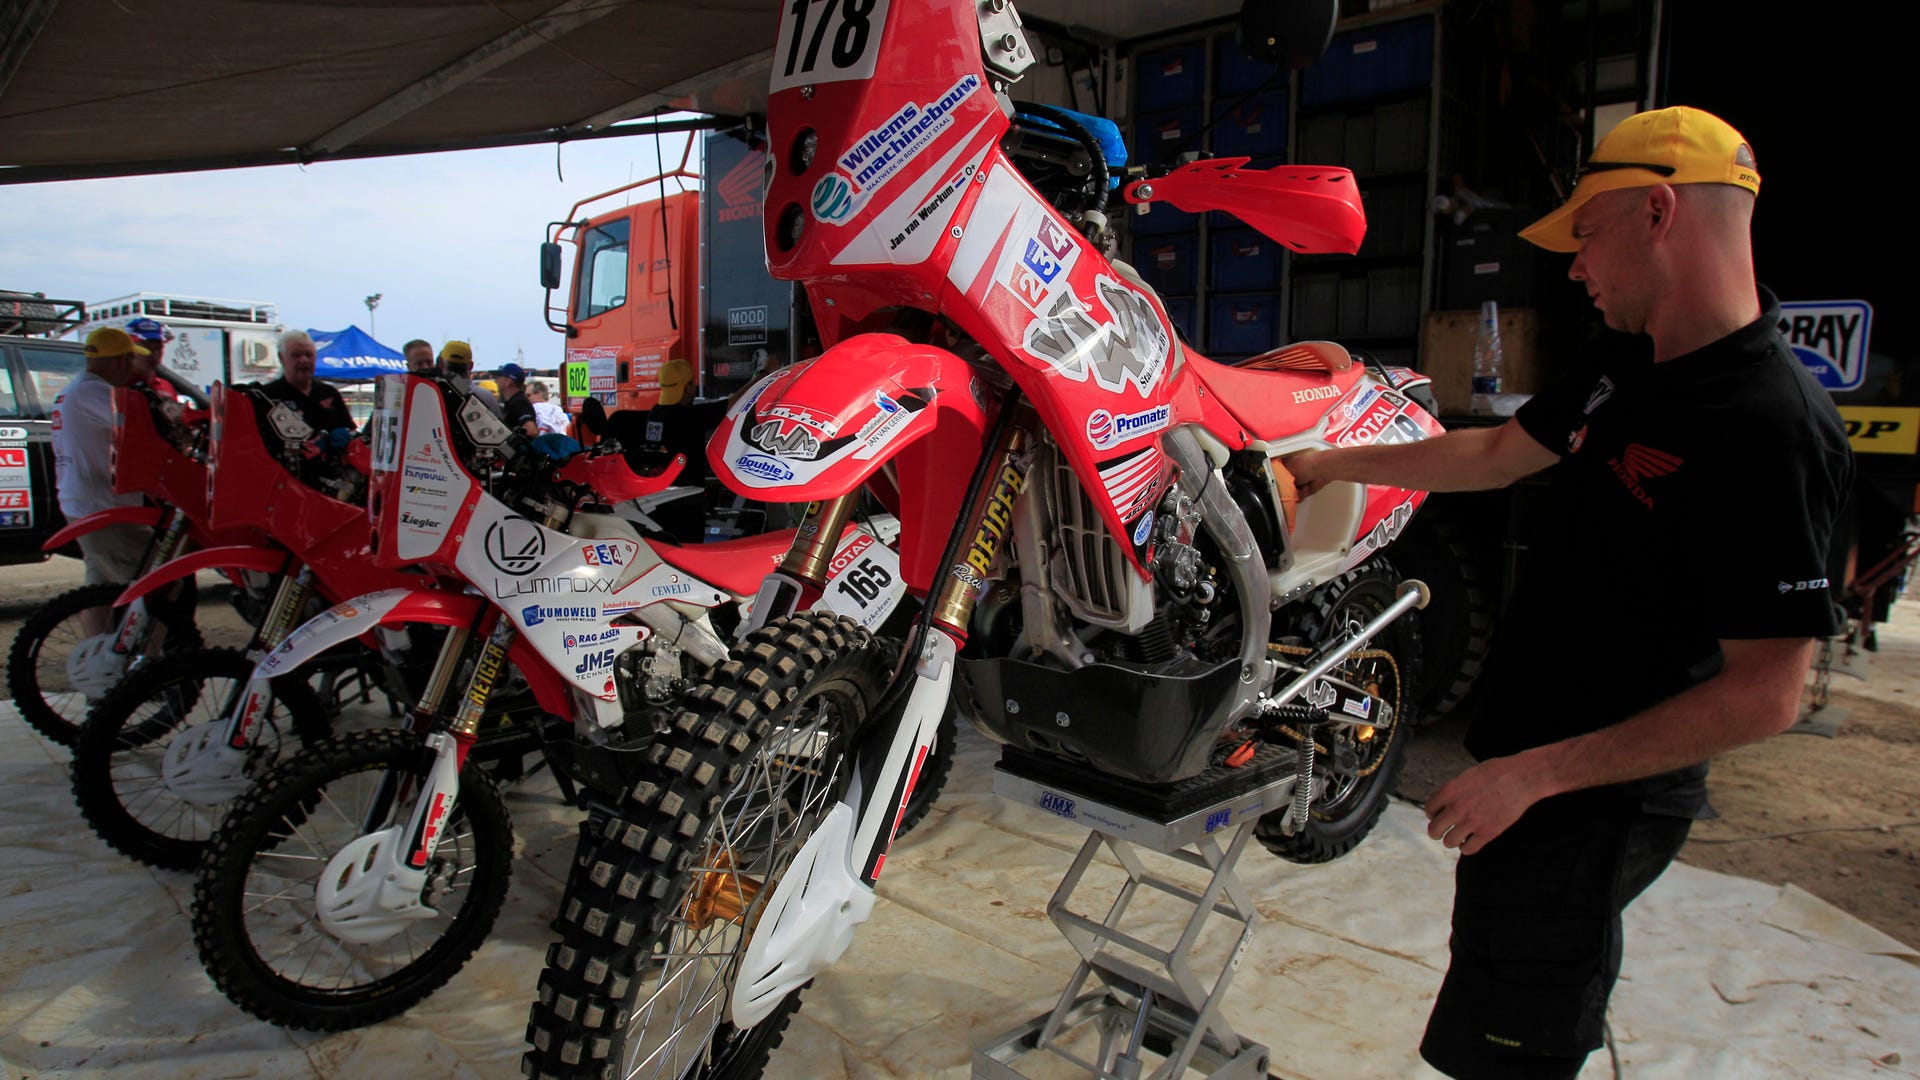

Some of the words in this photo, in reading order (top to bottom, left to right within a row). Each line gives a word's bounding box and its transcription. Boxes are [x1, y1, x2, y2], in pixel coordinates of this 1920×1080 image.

[784, 0, 872, 77] 178
[842, 104, 918, 171] Willems
[856, 75, 978, 186] machinebouw
[866, 163, 897, 192] MAATWERK
[903, 132, 934, 158] ROESTVAST
[933, 117, 951, 136] STAAL
[890, 233, 906, 250] Jan
[904, 218, 920, 236] van
[918, 184, 954, 222] Woerkum
[1048, 225, 1069, 253] 4
[1031, 247, 1056, 276] 3
[1019, 272, 1044, 303] 2
[731, 310, 765, 324] MOOD
[569, 367, 587, 392] 602
[1292, 384, 1342, 404] HONDA
[867, 435, 880, 447] JAN
[879, 425, 891, 437] VAN
[1342, 405, 1397, 447] TOTAL
[737, 456, 782, 473] Double
[401, 513, 442, 528] Ziegler
[967, 467, 1023, 576] REIGER
[828, 535, 875, 574] TOTAL
[651, 583, 691, 597] CEWELD
[838, 557, 892, 610] 165
[539, 607, 597, 618] KUMOWELD
[578, 634, 598, 643] RAG
[599, 628, 620, 641] ASSEN
[467, 643, 504, 706] REIGER
[575, 648, 615, 674] JMS
[1042, 791, 1076, 817] HMX
